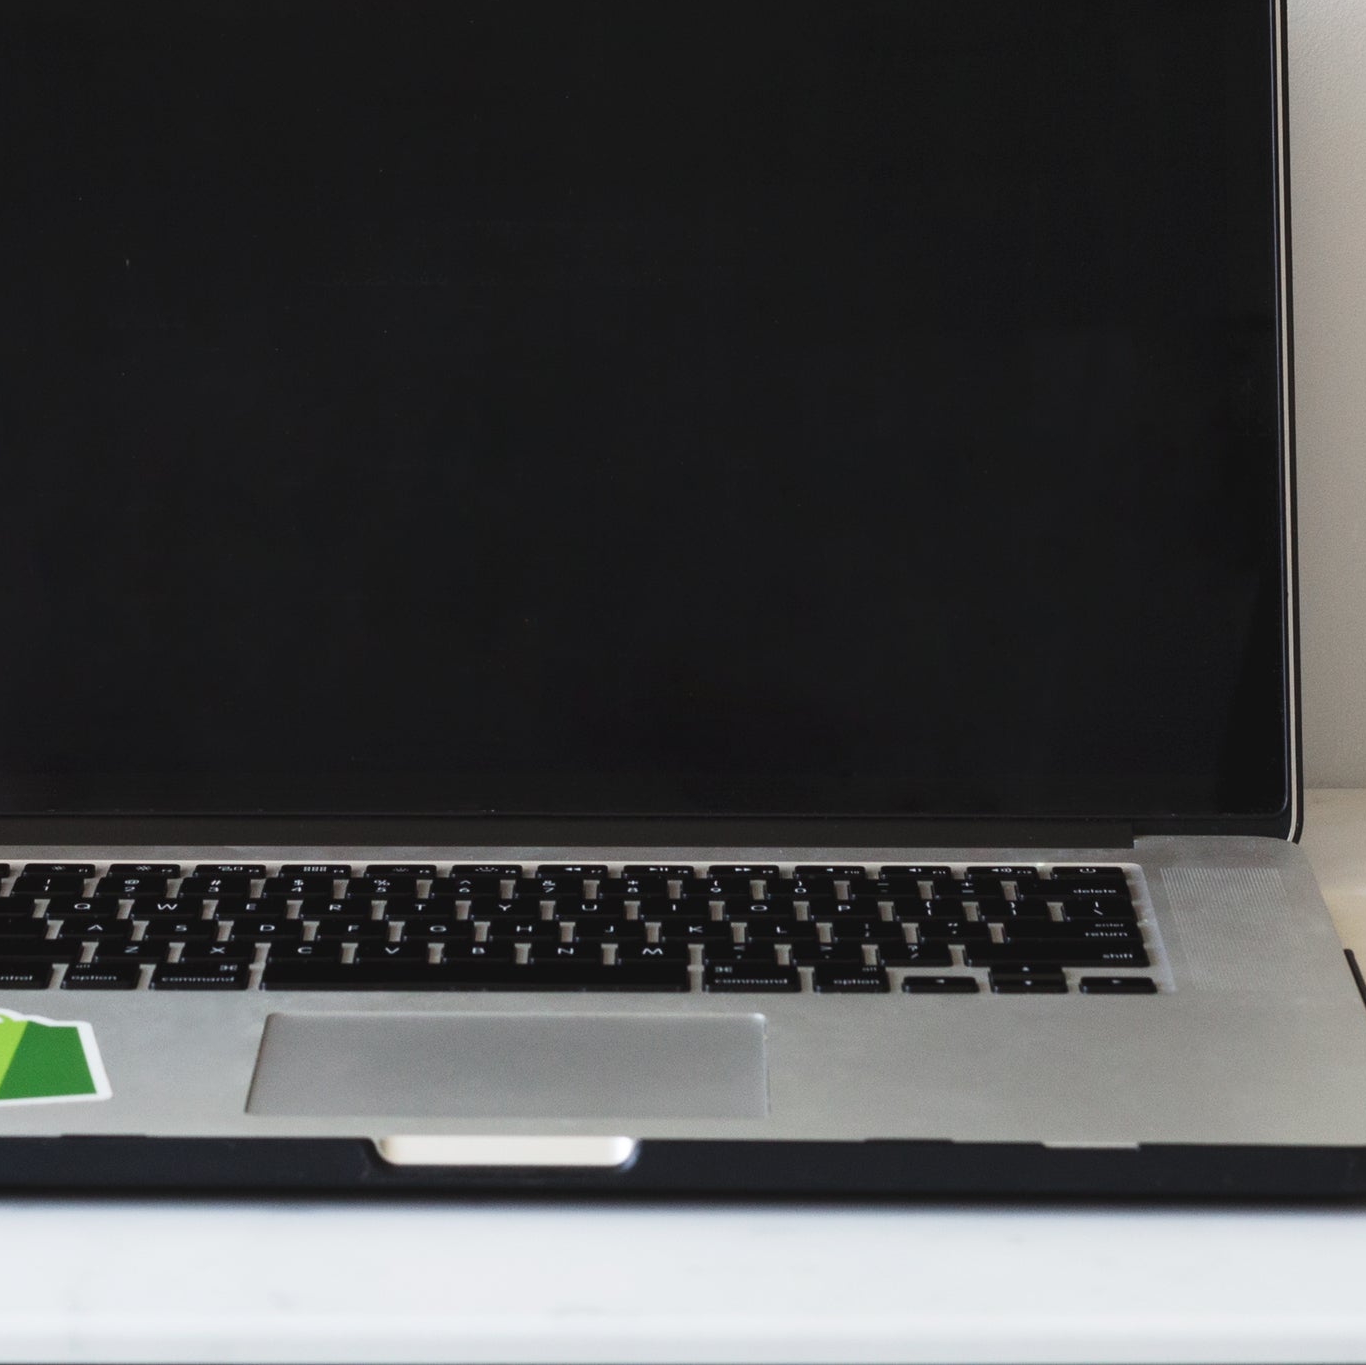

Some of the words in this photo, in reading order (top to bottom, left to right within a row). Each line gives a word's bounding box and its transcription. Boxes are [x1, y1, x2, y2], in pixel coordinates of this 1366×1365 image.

[157, 903, 178, 911] W
[245, 903, 257, 911] E
[414, 903, 426, 911] T
[498, 904, 512, 912] Y
[175, 924, 188, 932] S
[259, 924, 276, 932] D
[124, 945, 139, 954] Z
[210, 946, 225, 954] X
[297, 946, 312, 954] C
[385, 947, 400, 955] V
[557, 947, 575, 955] N
[642, 947, 664, 955] M
